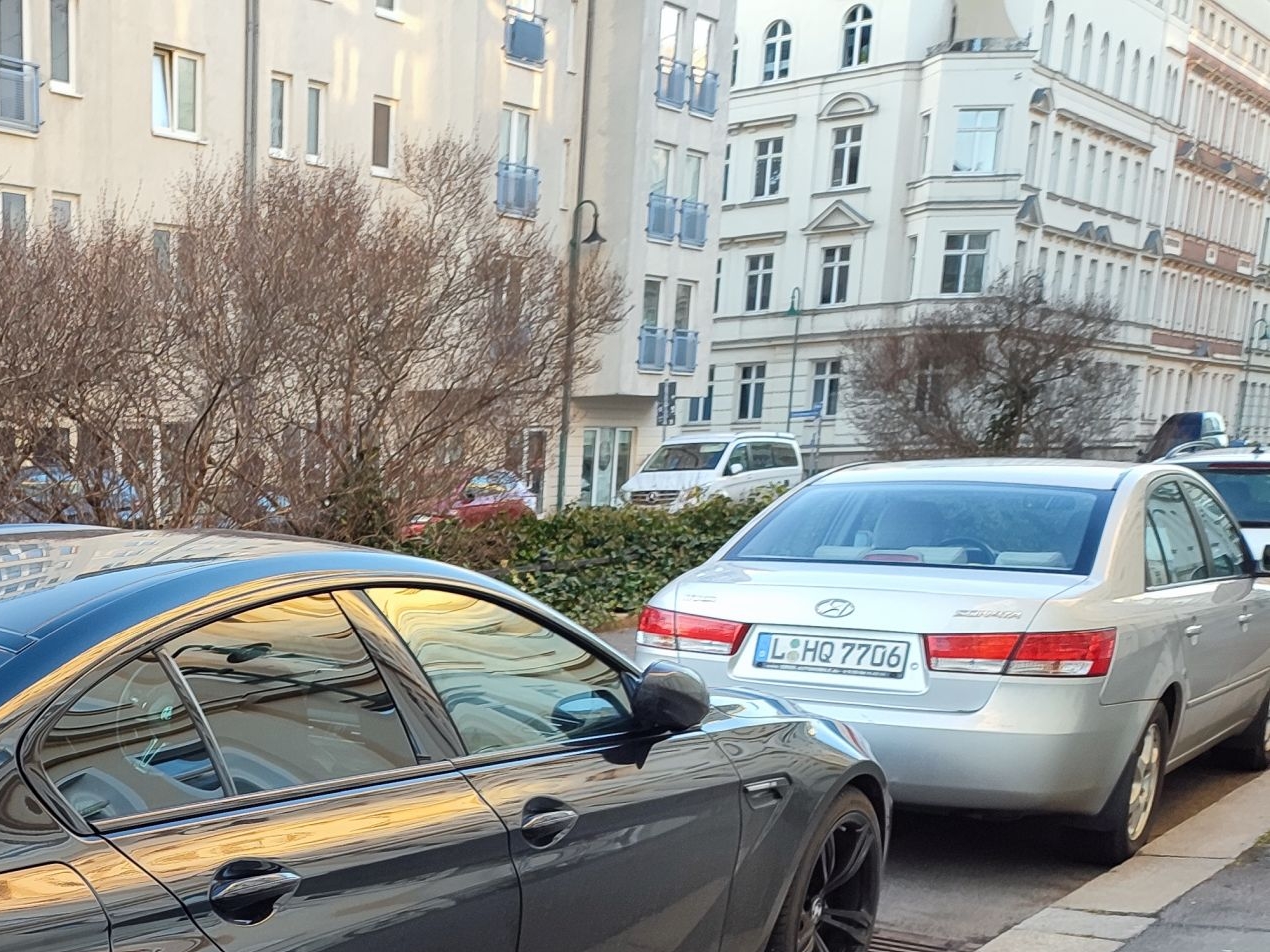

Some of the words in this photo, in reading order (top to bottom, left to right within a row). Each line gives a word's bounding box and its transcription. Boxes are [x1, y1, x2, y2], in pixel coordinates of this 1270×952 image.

[771, 638, 785, 660] L
[802, 640, 834, 664] HQ
[840, 642, 901, 668] 7706
